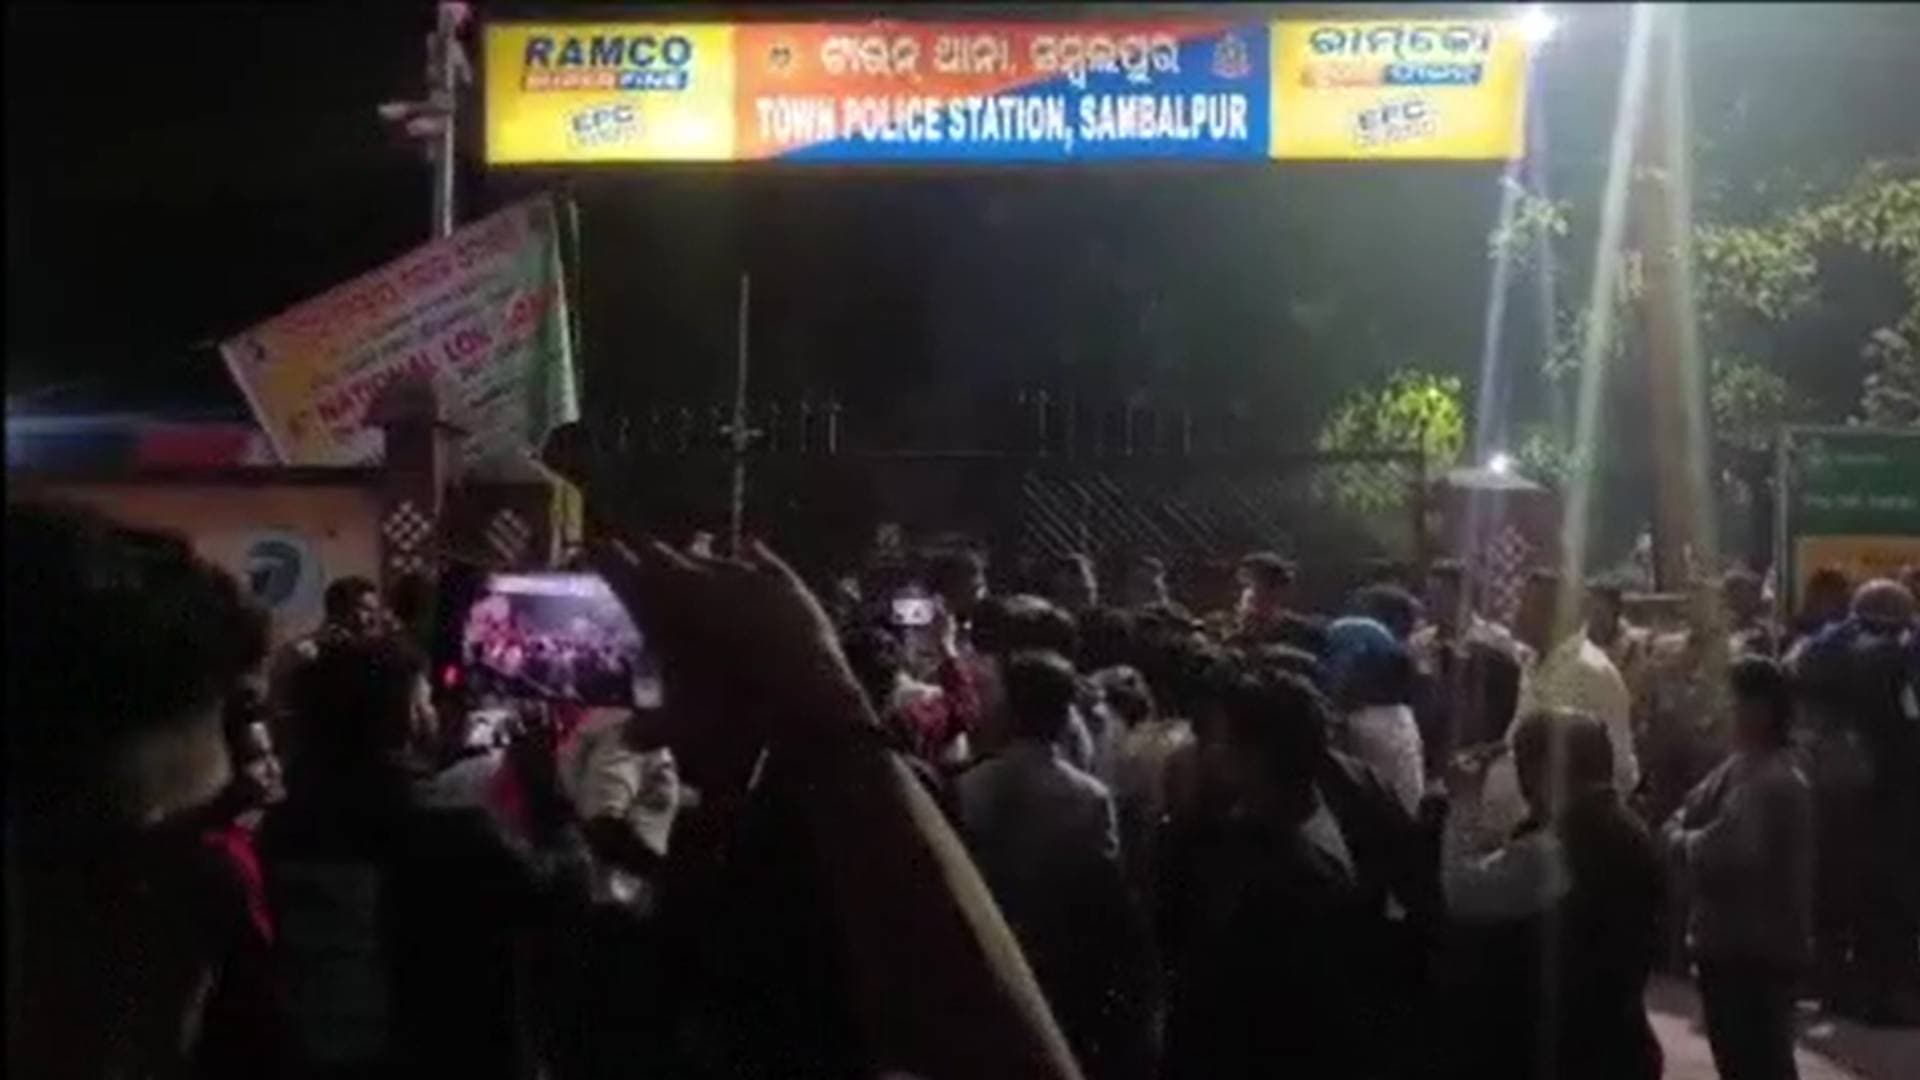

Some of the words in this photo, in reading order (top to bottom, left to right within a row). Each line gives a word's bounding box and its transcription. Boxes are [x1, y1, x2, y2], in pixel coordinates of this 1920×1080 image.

[524, 34, 693, 67] RAMCO
[757, 96, 837, 140] TOWN
[844, 96, 942, 142] POLICE
[948, 95, 1073, 154] STATION,
[1079, 93, 1249, 141] SAMBALPUR
